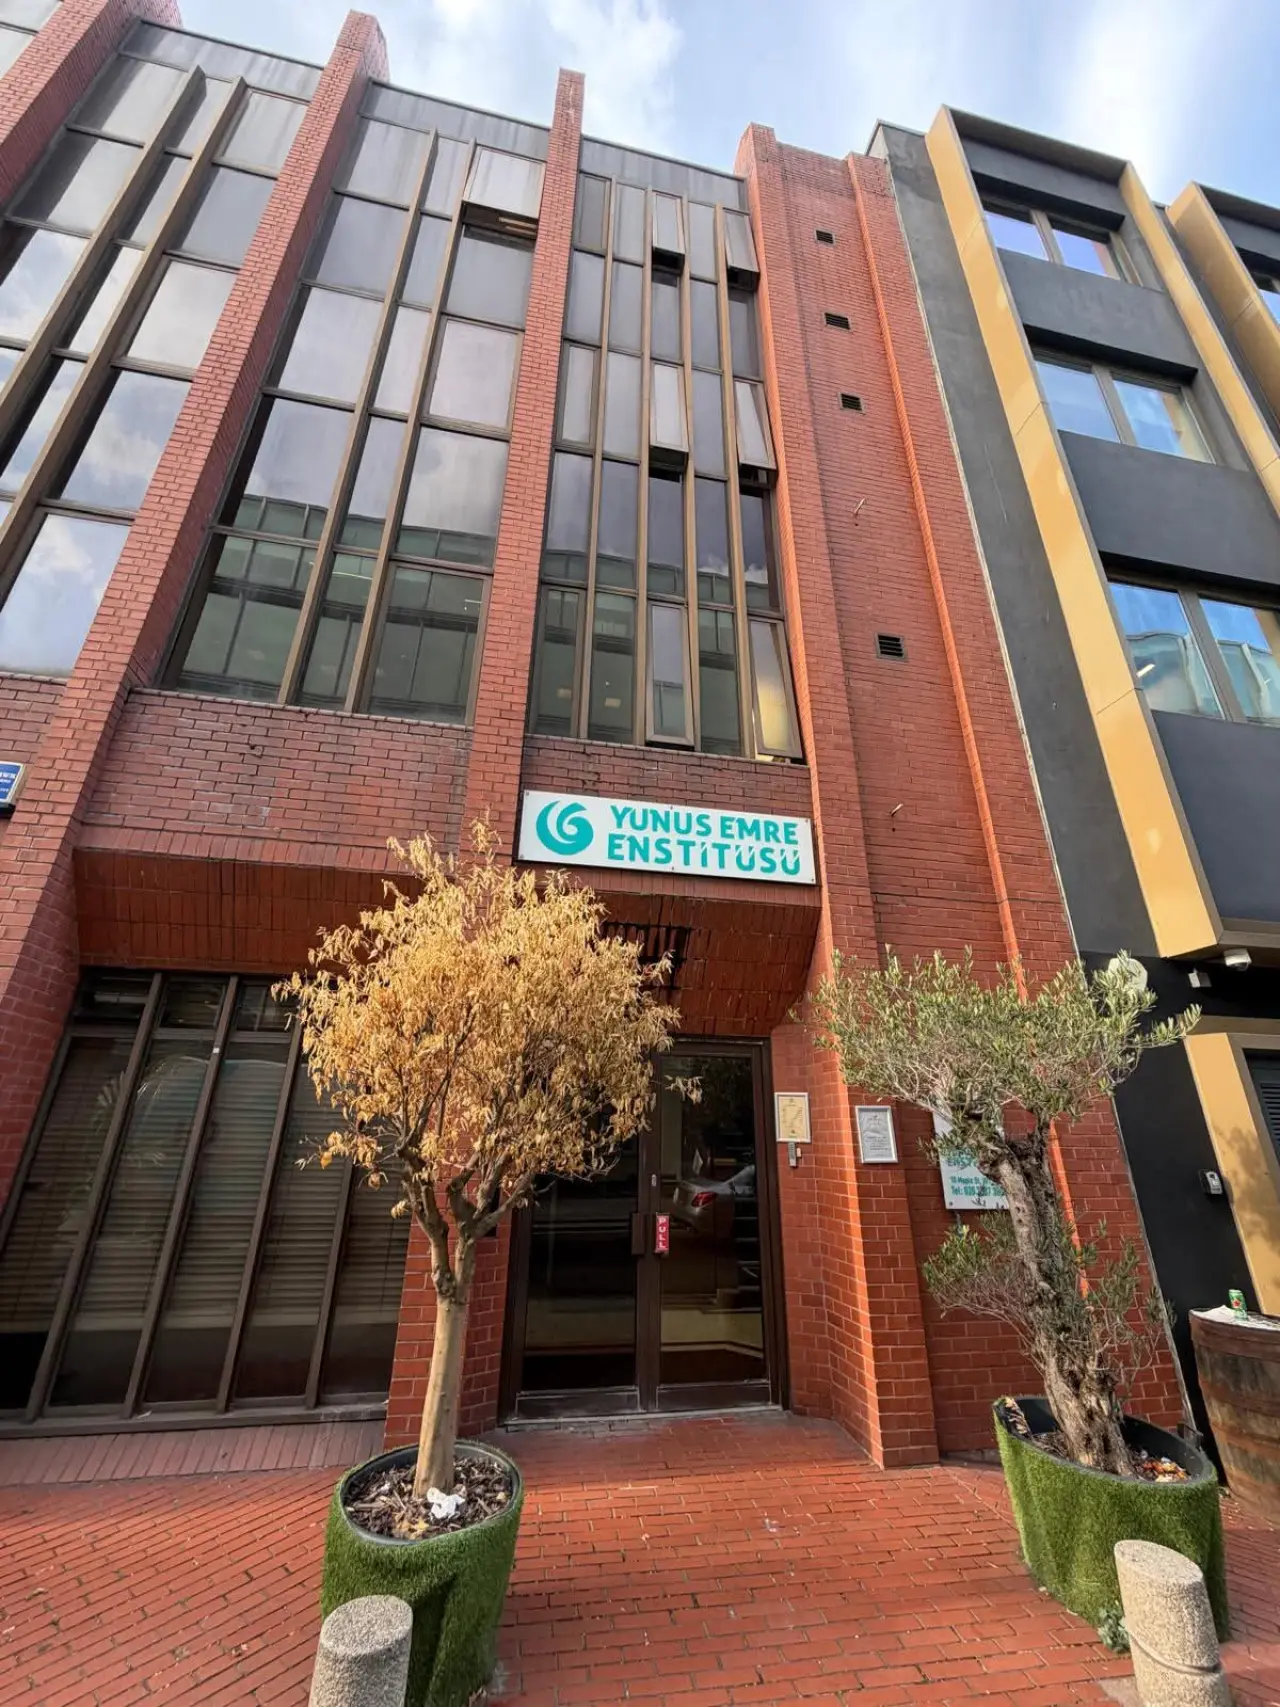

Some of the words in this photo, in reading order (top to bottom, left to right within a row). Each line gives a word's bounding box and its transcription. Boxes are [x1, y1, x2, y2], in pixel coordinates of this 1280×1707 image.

[610, 805, 712, 837] YUNUS
[720, 815, 799, 846] EMRE
[658, 1217, 667, 1249] PULL
